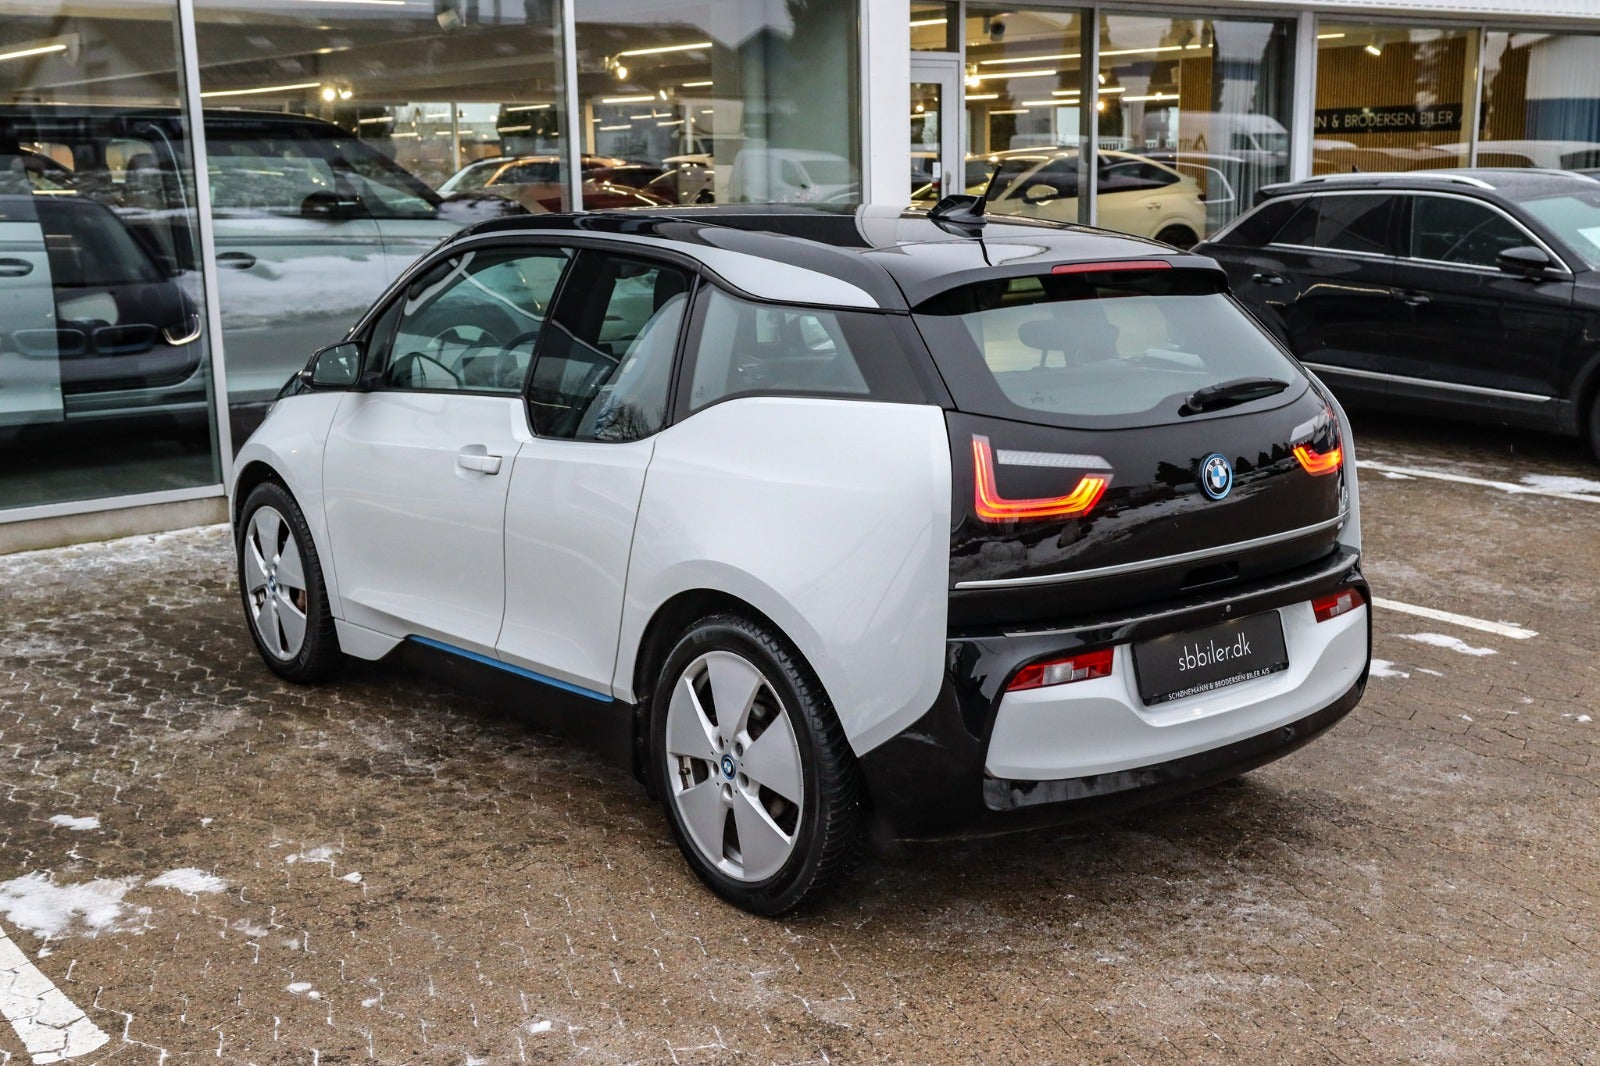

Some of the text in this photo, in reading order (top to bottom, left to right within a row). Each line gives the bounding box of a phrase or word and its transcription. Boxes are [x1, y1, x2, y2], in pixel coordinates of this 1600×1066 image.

[1332, 114, 1339, 128] &
[1344, 113, 1415, 127] BRODERSEN
[1207, 458, 1227, 471] BMW
[1178, 632, 1252, 671] sbbiler.dk
[1214, 675, 1246, 687] BRODERSEN
[1246, 670, 1260, 680] BILER
